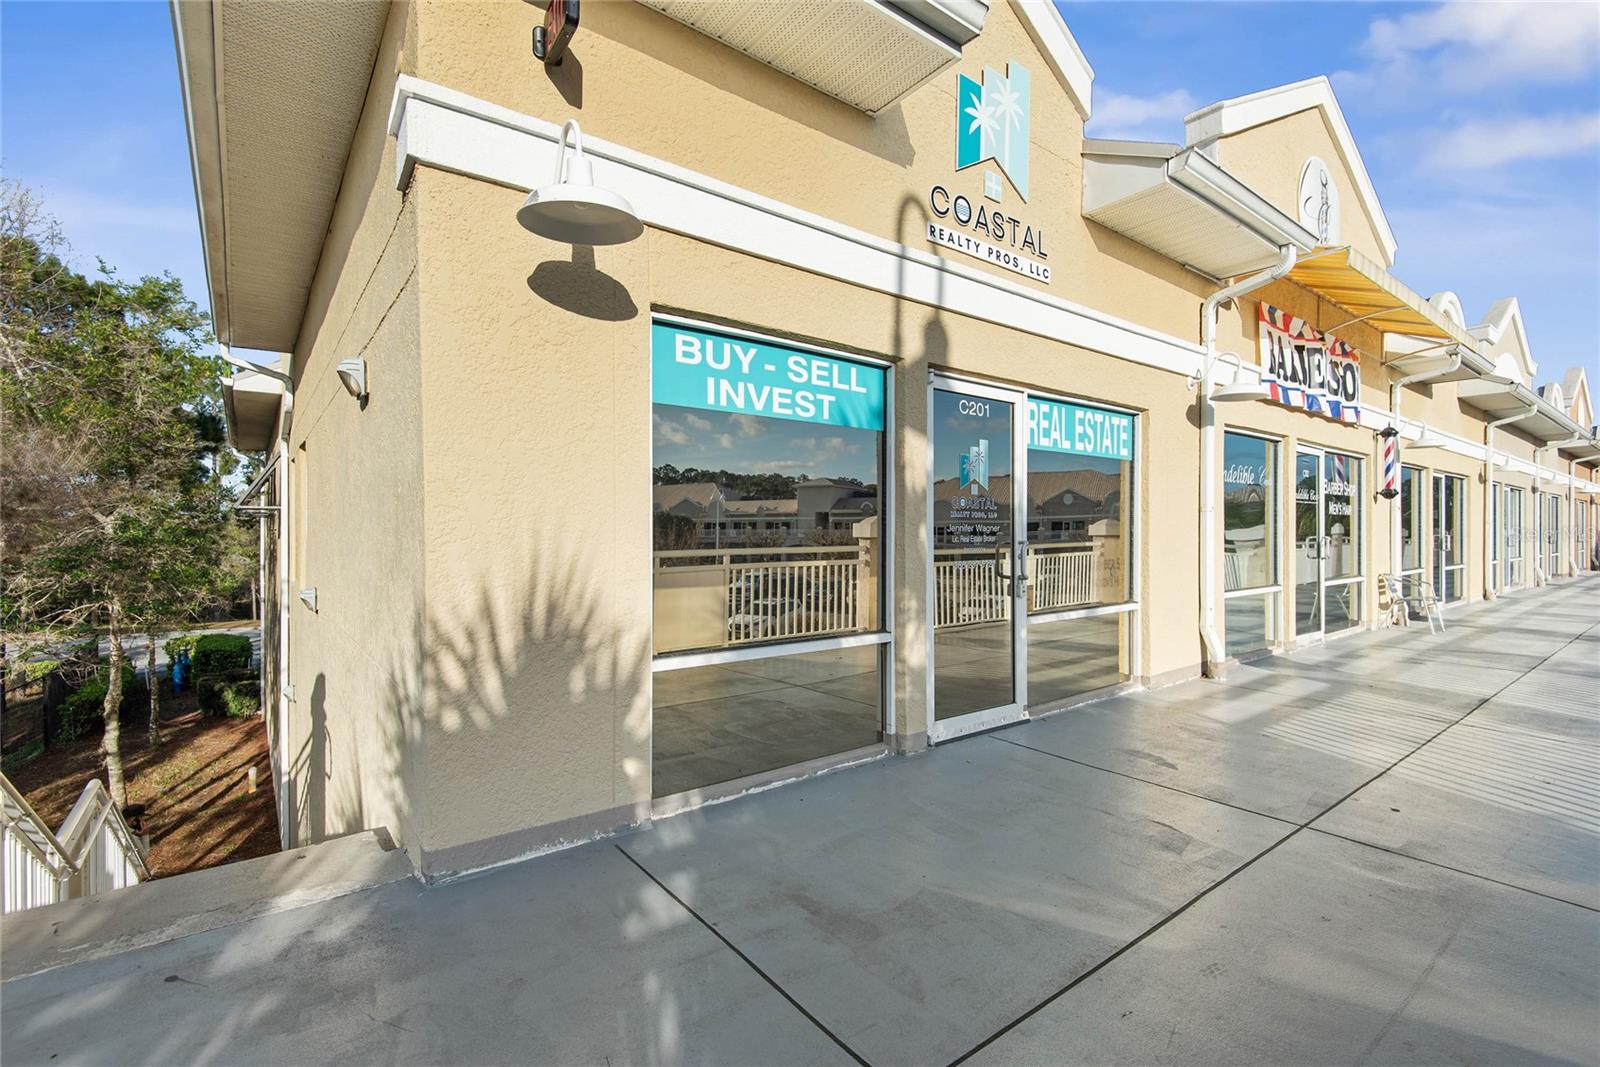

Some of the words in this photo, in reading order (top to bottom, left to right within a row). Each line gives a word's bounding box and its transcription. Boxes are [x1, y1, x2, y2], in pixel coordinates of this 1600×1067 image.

[931, 185, 1048, 257] COASTAL
[929, 224, 980, 253] REALTY
[988, 247, 1023, 271] PROS,
[1029, 263, 1050, 279] LLC
[675, 333, 758, 374] BUY
[787, 355, 867, 394] SELL
[707, 376, 836, 420] INVEST
[959, 399, 990, 418] C201
[1026, 401, 1071, 449] REAL
[1075, 409, 1129, 457] ESTATE
[946, 523, 974, 533] Jennifer
[975, 524, 1000, 534] Wagner
